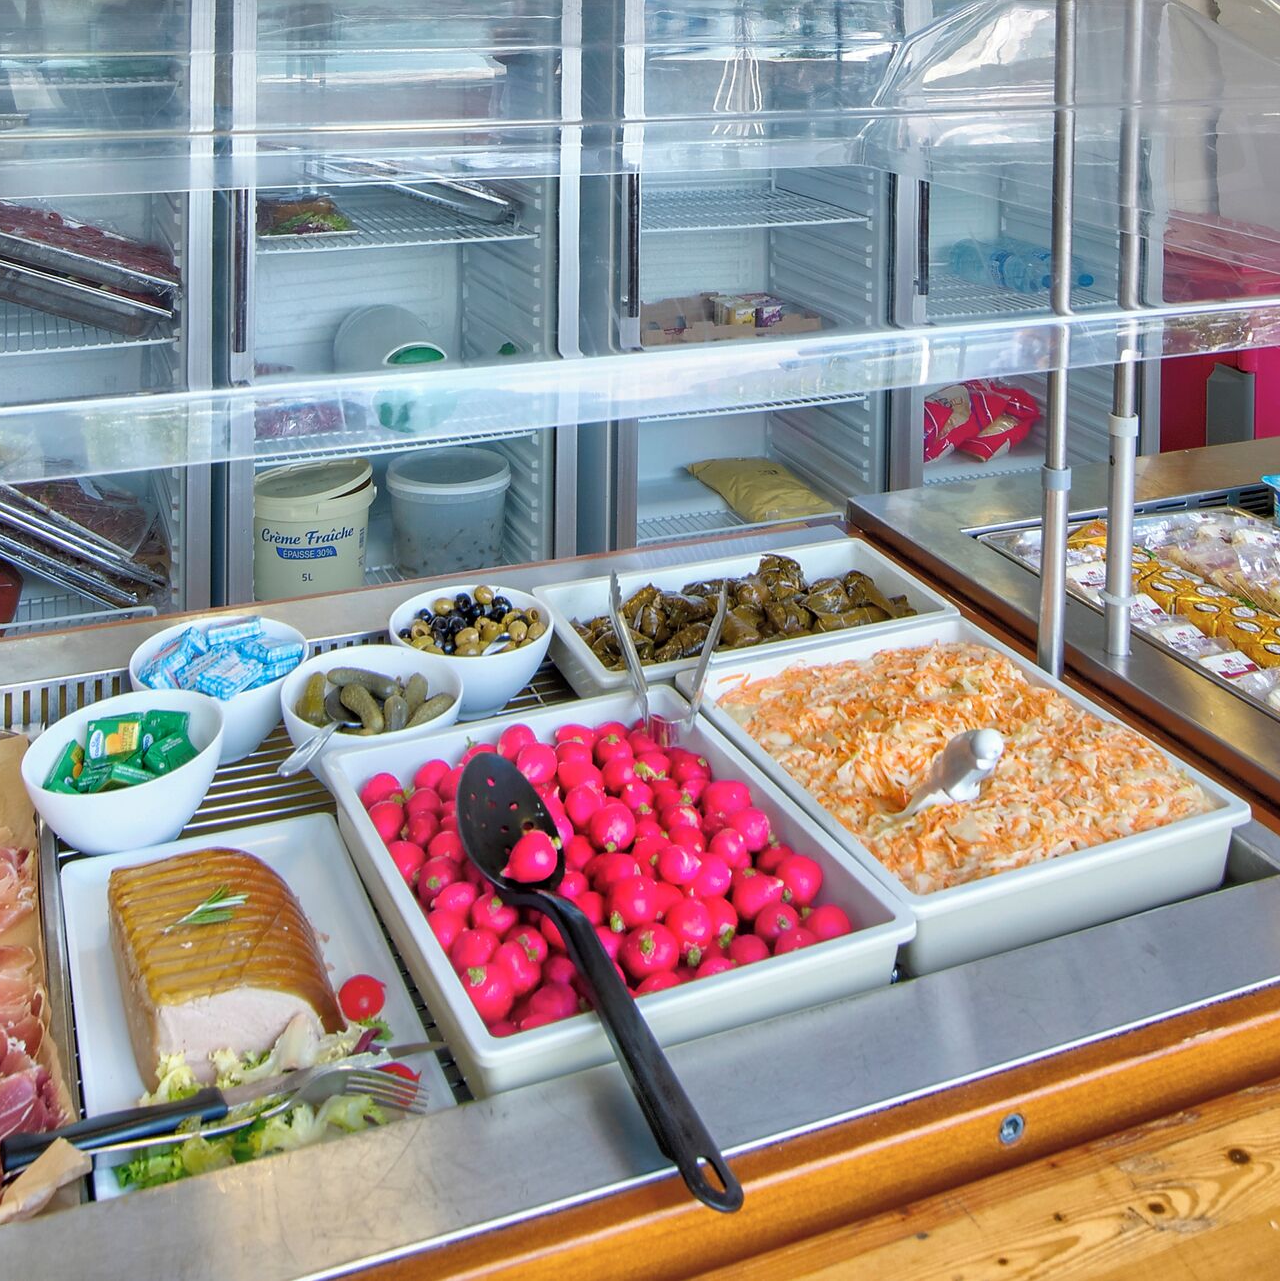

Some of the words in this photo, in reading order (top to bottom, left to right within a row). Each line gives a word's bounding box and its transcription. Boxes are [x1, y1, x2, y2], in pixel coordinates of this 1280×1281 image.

[261, 528, 301, 545] Crème
[305, 527, 354, 545] Fraîche
[283, 547, 315, 558] ÉPAISSE
[317, 547, 333, 557] 30%
[302, 573, 313, 582] 5L
